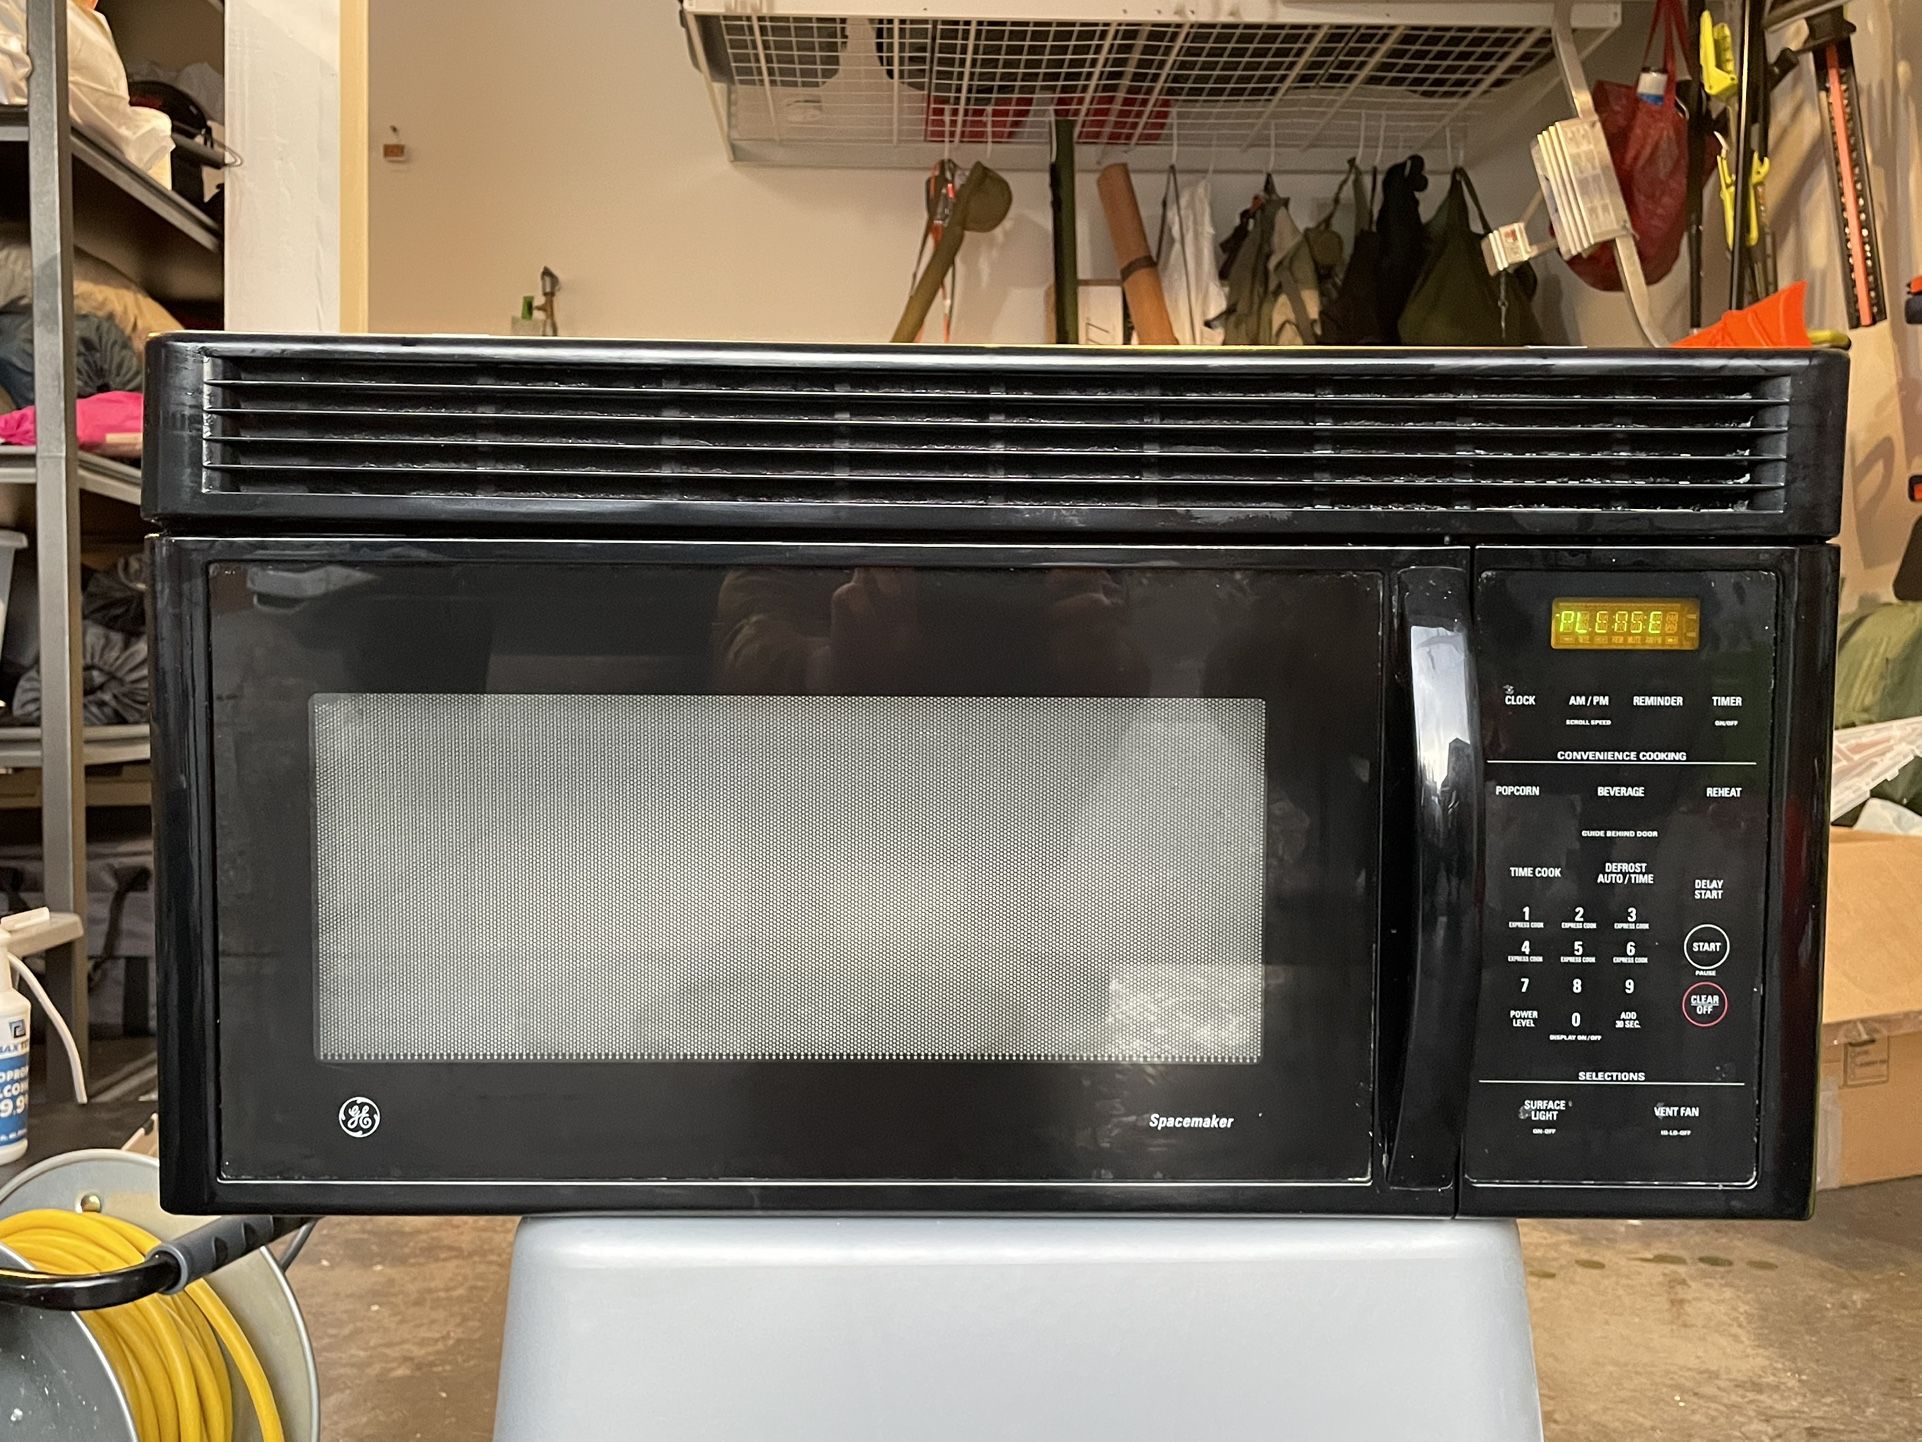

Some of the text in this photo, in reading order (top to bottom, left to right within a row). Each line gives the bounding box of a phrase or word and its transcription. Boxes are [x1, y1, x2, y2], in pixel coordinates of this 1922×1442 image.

[1559, 610, 1663, 634] PLEASE
[1504, 695, 1536, 706] CLOCK
[1632, 695, 1684, 707] REMINDER
[1711, 696, 1743, 707] TIMER
[1556, 750, 1687, 761] CONVENIENCE COOKING
[1495, 785, 1540, 796] POPCORN
[1597, 786, 1645, 797] BEVERAGE
[1706, 787, 1742, 798] REHEAT
[1636, 830, 1659, 838] DOOR
[1509, 866, 1562, 878] TIME COOK
[1605, 862, 1648, 873] DEFROST
[1694, 879, 1724, 890] DELAY
[1694, 889, 1723, 900] START
[1522, 906, 1530, 921] 1
[1574, 906, 1584, 922] 2
[1627, 907, 1637, 922] 3
[1521, 940, 1531, 955] 4
[1573, 940, 1583, 956] 5
[1626, 941, 1636, 956] 6
[1692, 942, 1722, 952] START
[1520, 978, 1530, 993] 7
[1572, 978, 1582, 994] 8
[1625, 979, 1635, 994] 9
[1690, 995, 1720, 1004] CLEAR
[1509, 1009, 1539, 1019] POWER
[1620, 1011, 1638, 1020] ADD
[1696, 1005, 1714, 1015] OFF
[1512, 1019, 1536, 1028] LEVEL
[1571, 1012, 1581, 1028] 0
[1615, 1020, 1642, 1029] 30 SEC.
[1578, 1071, 1646, 1082] SELECTIONS
[1524, 1100, 1566, 1110] SURFACE
[1531, 1110, 1559, 1120] LIGHT
[1653, 1106, 1700, 1117] VENT FAN
[1149, 1113, 1235, 1131] Spacemaker
